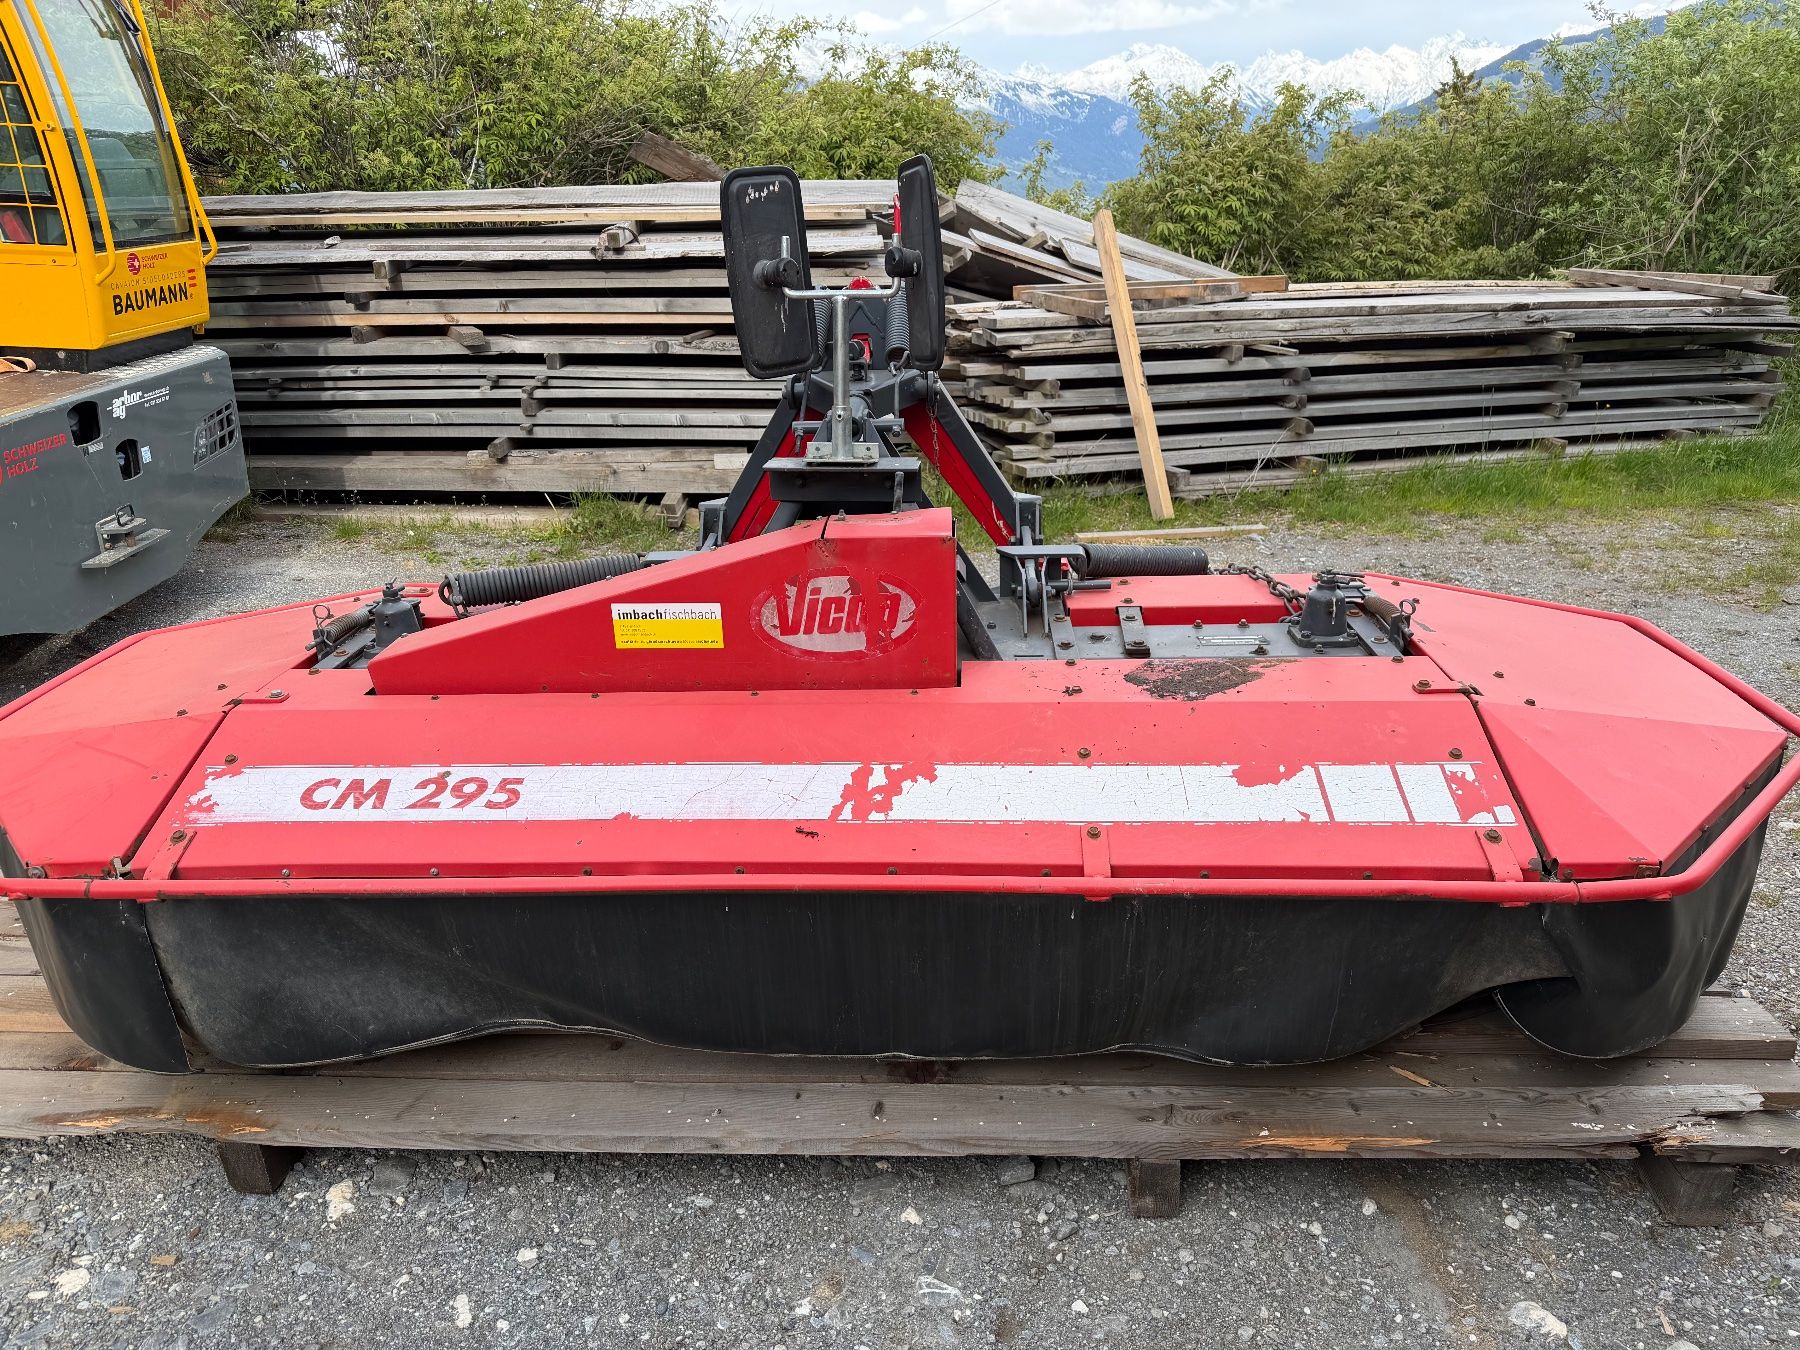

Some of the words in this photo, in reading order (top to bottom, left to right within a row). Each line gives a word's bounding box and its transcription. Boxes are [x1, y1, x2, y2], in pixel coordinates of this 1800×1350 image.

[112, 281, 188, 316] BAUMANN
[112, 389, 142, 408] arbor
[112, 405, 126, 419] ag
[3, 433, 68, 464] SCHWEIZER
[7, 457, 39, 478] HOLZ
[617, 608, 717, 620] imbachfischbach
[299, 777, 392, 811] CM
[404, 776, 526, 811] 295
